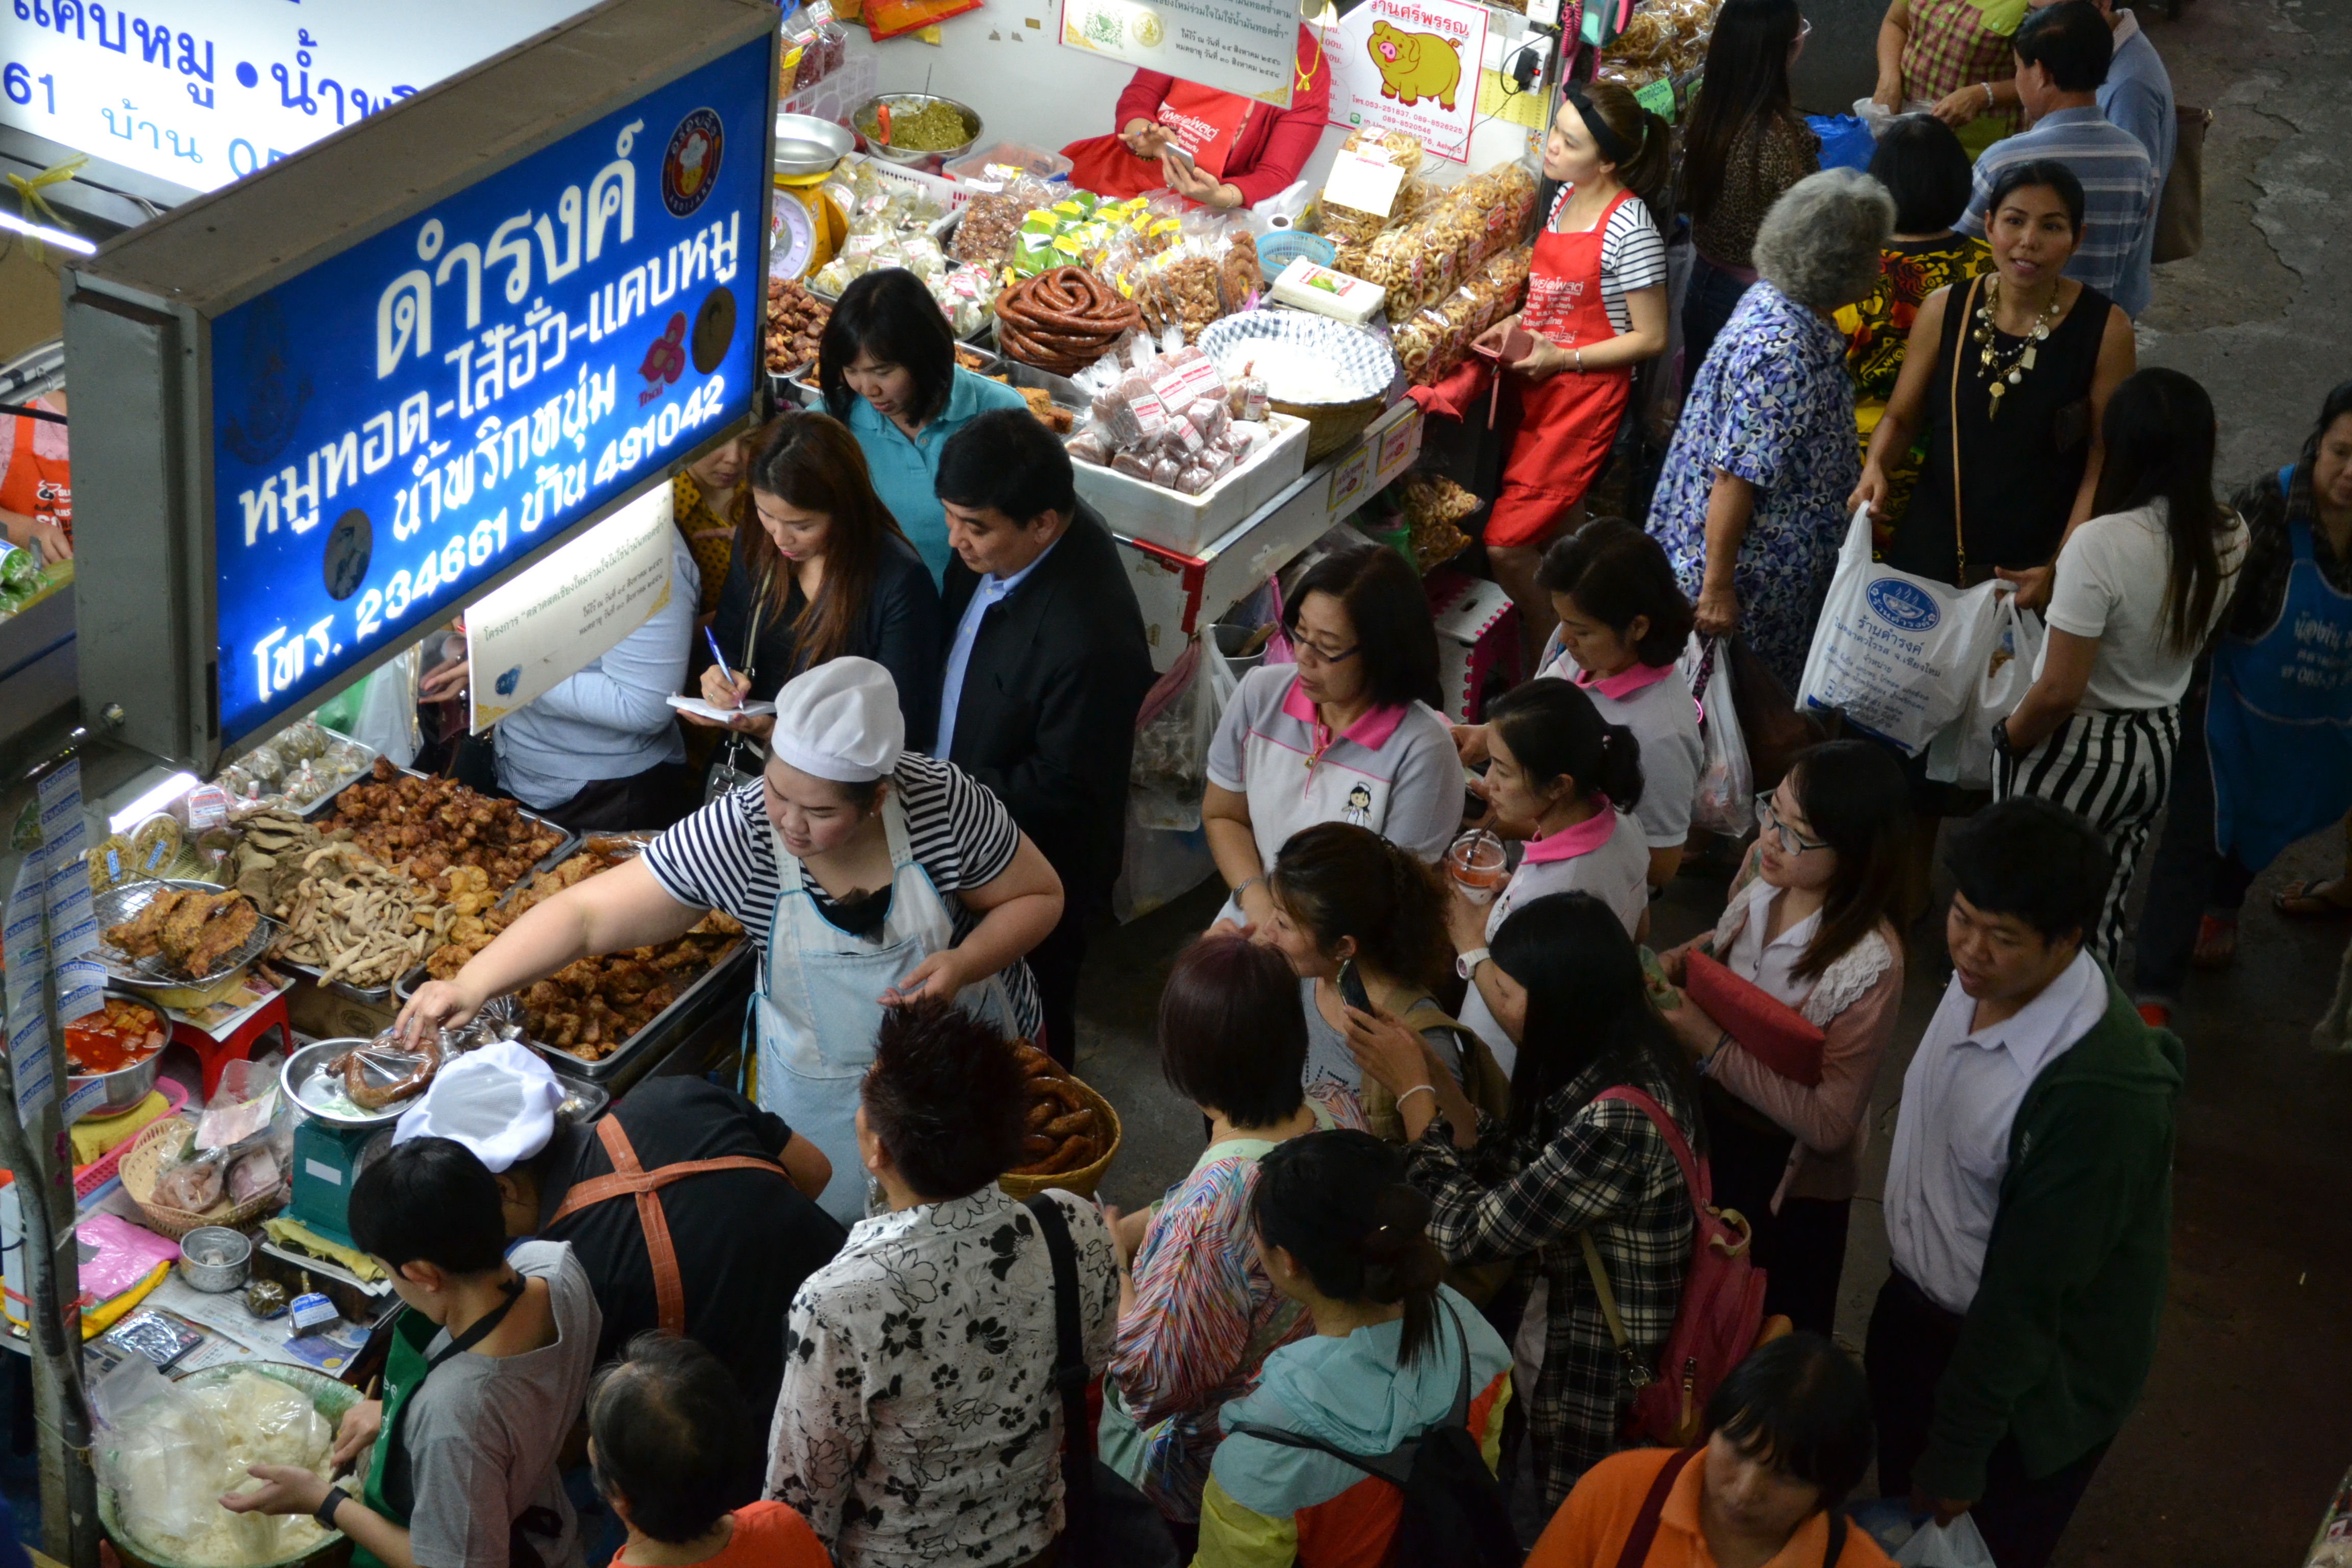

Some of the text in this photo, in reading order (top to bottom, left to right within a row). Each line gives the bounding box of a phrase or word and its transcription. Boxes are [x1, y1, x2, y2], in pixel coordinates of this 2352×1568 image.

[101, 98, 203, 163] บ้าน
[1383, 115, 1431, 134] 089-8520546
[376, 118, 644, 380] ดำรงค์
[393, 361, 616, 542] น้ำพริกหนุ่ม
[254, 614, 342, 703] โทร.
[356, 506, 508, 643] 234661
[520, 458, 586, 534] บ้าน
[1858, 615, 1925, 656] ร้านดำรงค์
